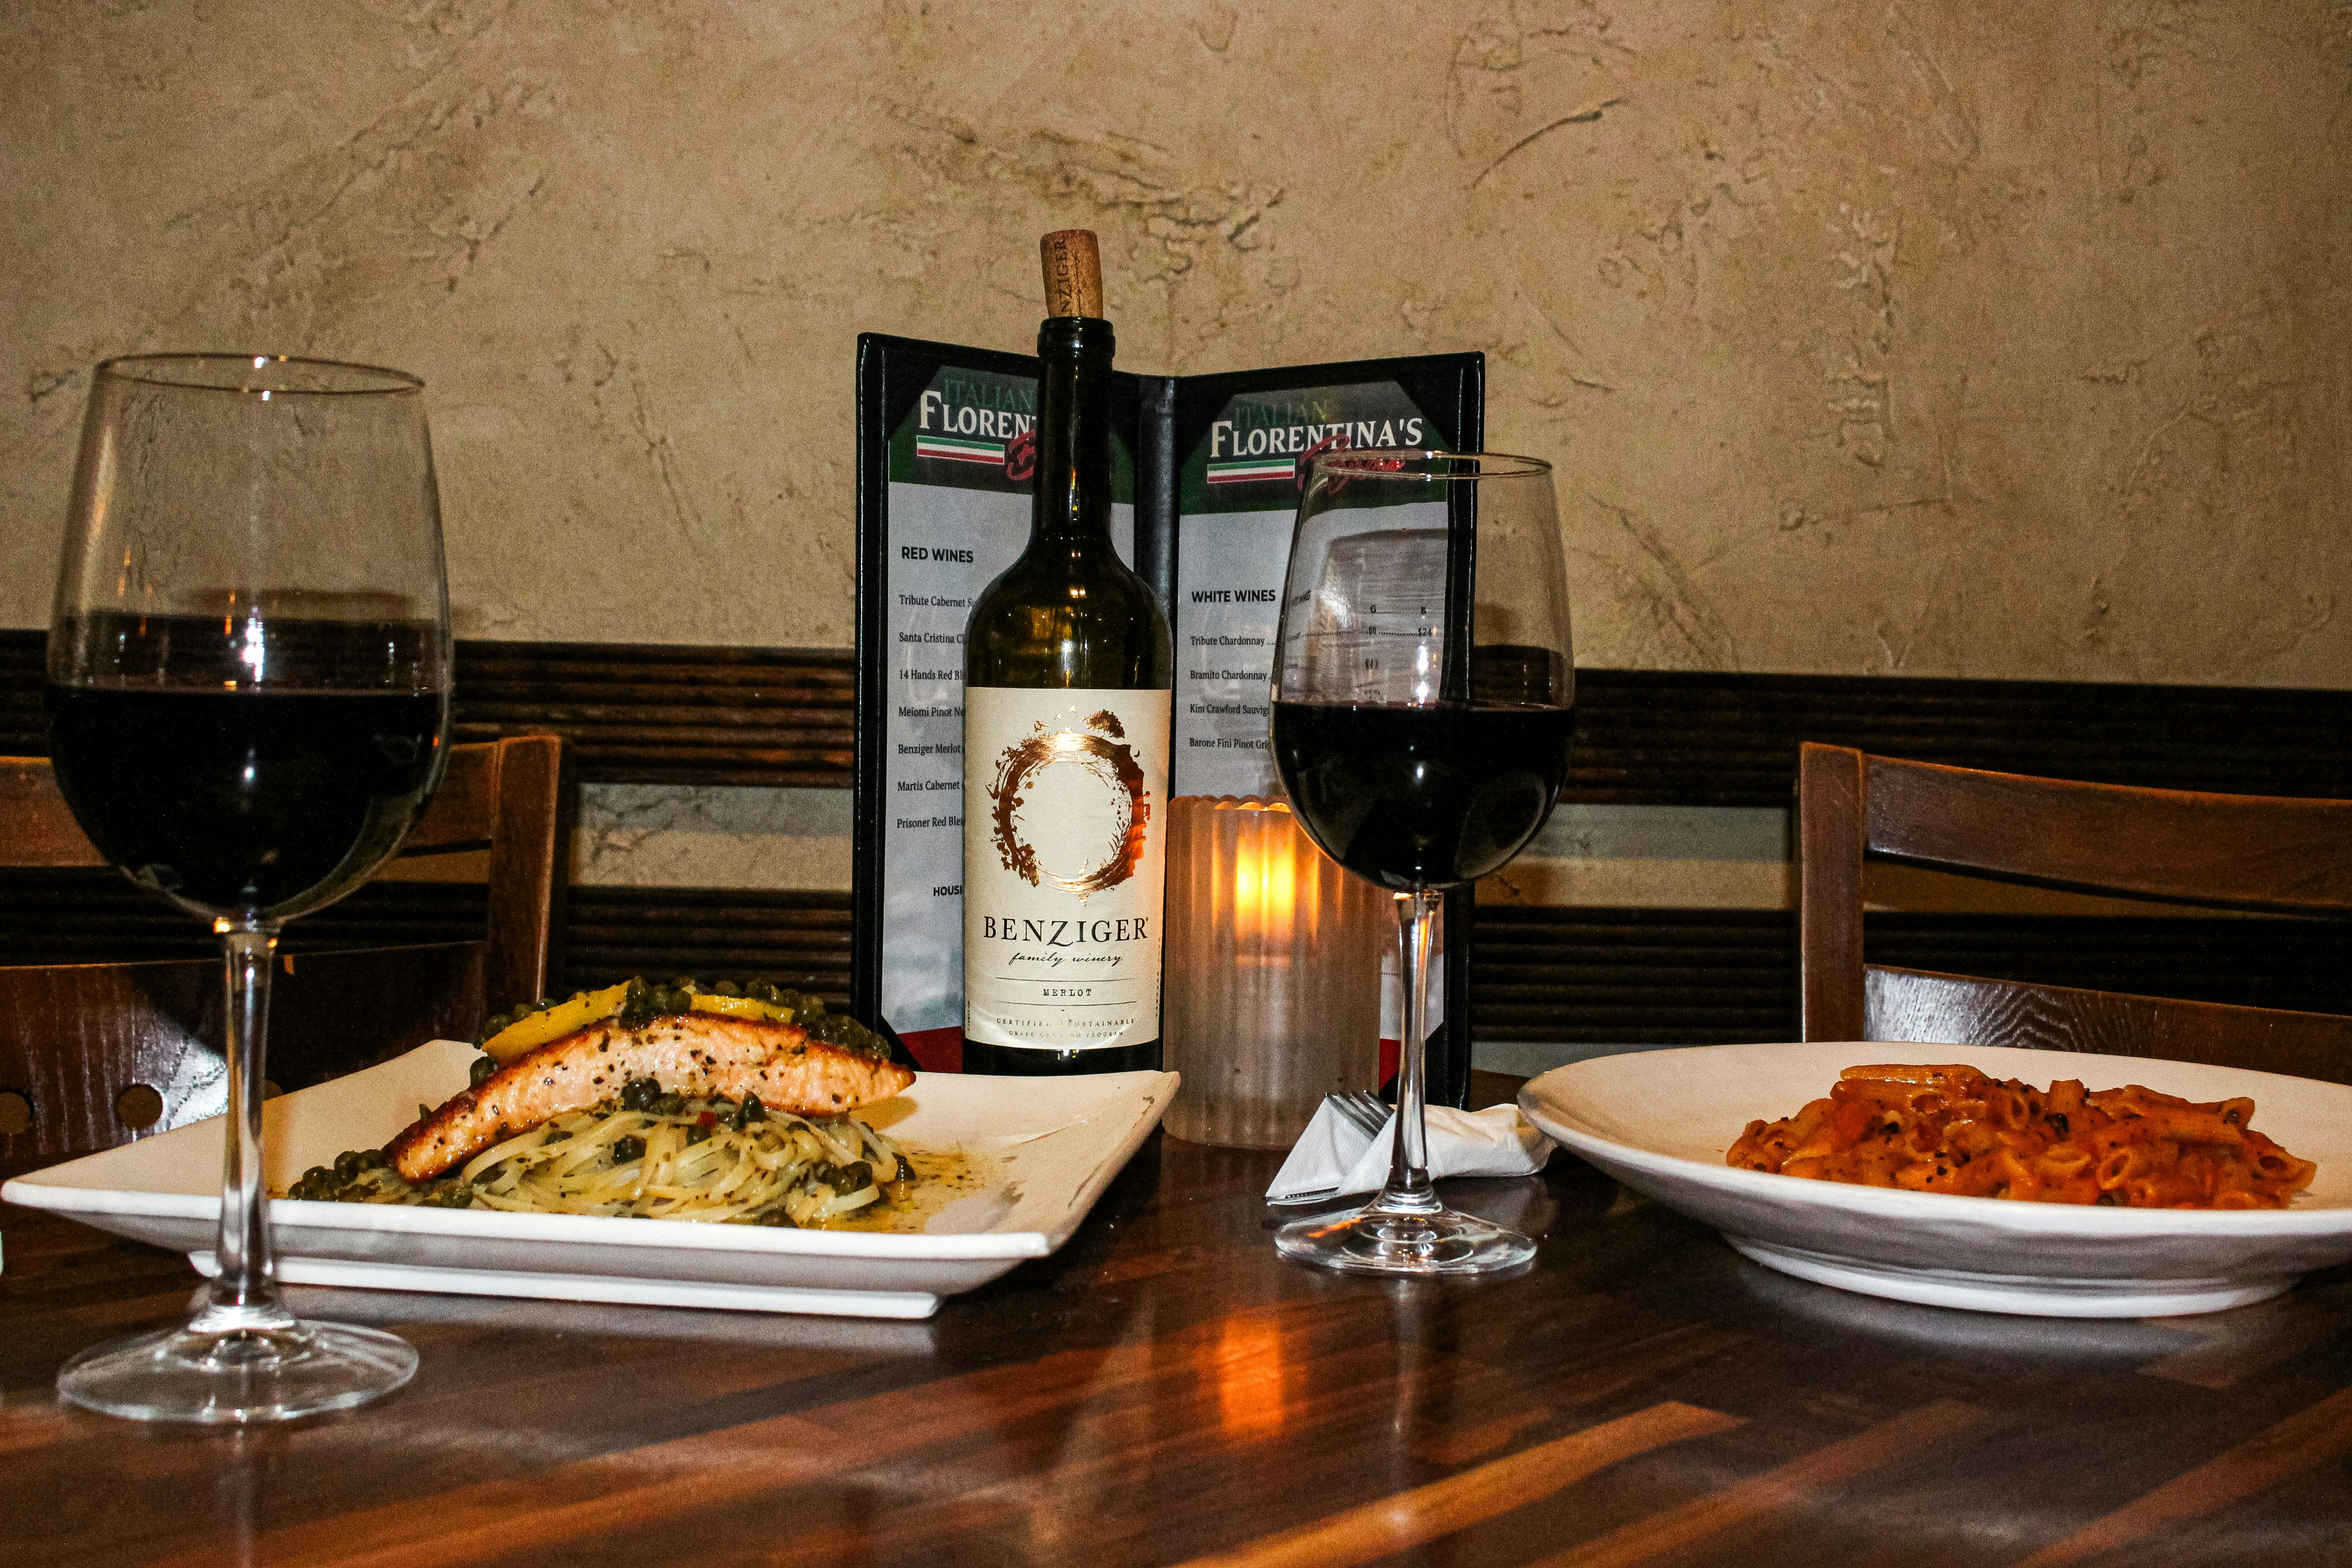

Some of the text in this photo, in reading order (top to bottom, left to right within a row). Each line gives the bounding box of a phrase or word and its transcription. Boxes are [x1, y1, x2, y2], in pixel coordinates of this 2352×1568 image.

[919, 390, 1037, 440] FLOREN
[1210, 418, 1424, 458] FLORENTINA'S
[901, 546, 974, 563] RED WINES
[899, 594, 929, 606] Tribute
[931, 596, 965, 607] Cabernet
[1191, 590, 1276, 603] WHITE WINES
[899, 632, 922, 642] Santa
[924, 633, 955, 643] Cristina
[1190, 635, 1265, 647] Tribute Chardonnay
[900, 669, 965, 680] 14 Hands Red Bl
[1190, 670, 1267, 681] Bramito Chardonnay
[898, 706, 929, 717] Meiomi
[931, 706, 952, 717] Pinot
[1190, 704, 1205, 713] Kim
[1206, 704, 1240, 714] Crawford
[898, 744, 933, 756] Benziger
[935, 743, 961, 754] Merlot
[1189, 738, 1215, 748] Barone
[1217, 738, 1231, 748] Fini
[1234, 739, 1254, 749] Pinot
[897, 780, 923, 791] Martis
[925, 780, 960, 790] Cabernet
[897, 818, 930, 828] Prisoner
[932, 816, 946, 827] Red
[983, 916, 1147, 947] BENZIGER
[1008, 952, 1124, 968] family winery
[1043, 988, 1092, 997] MERLOT
